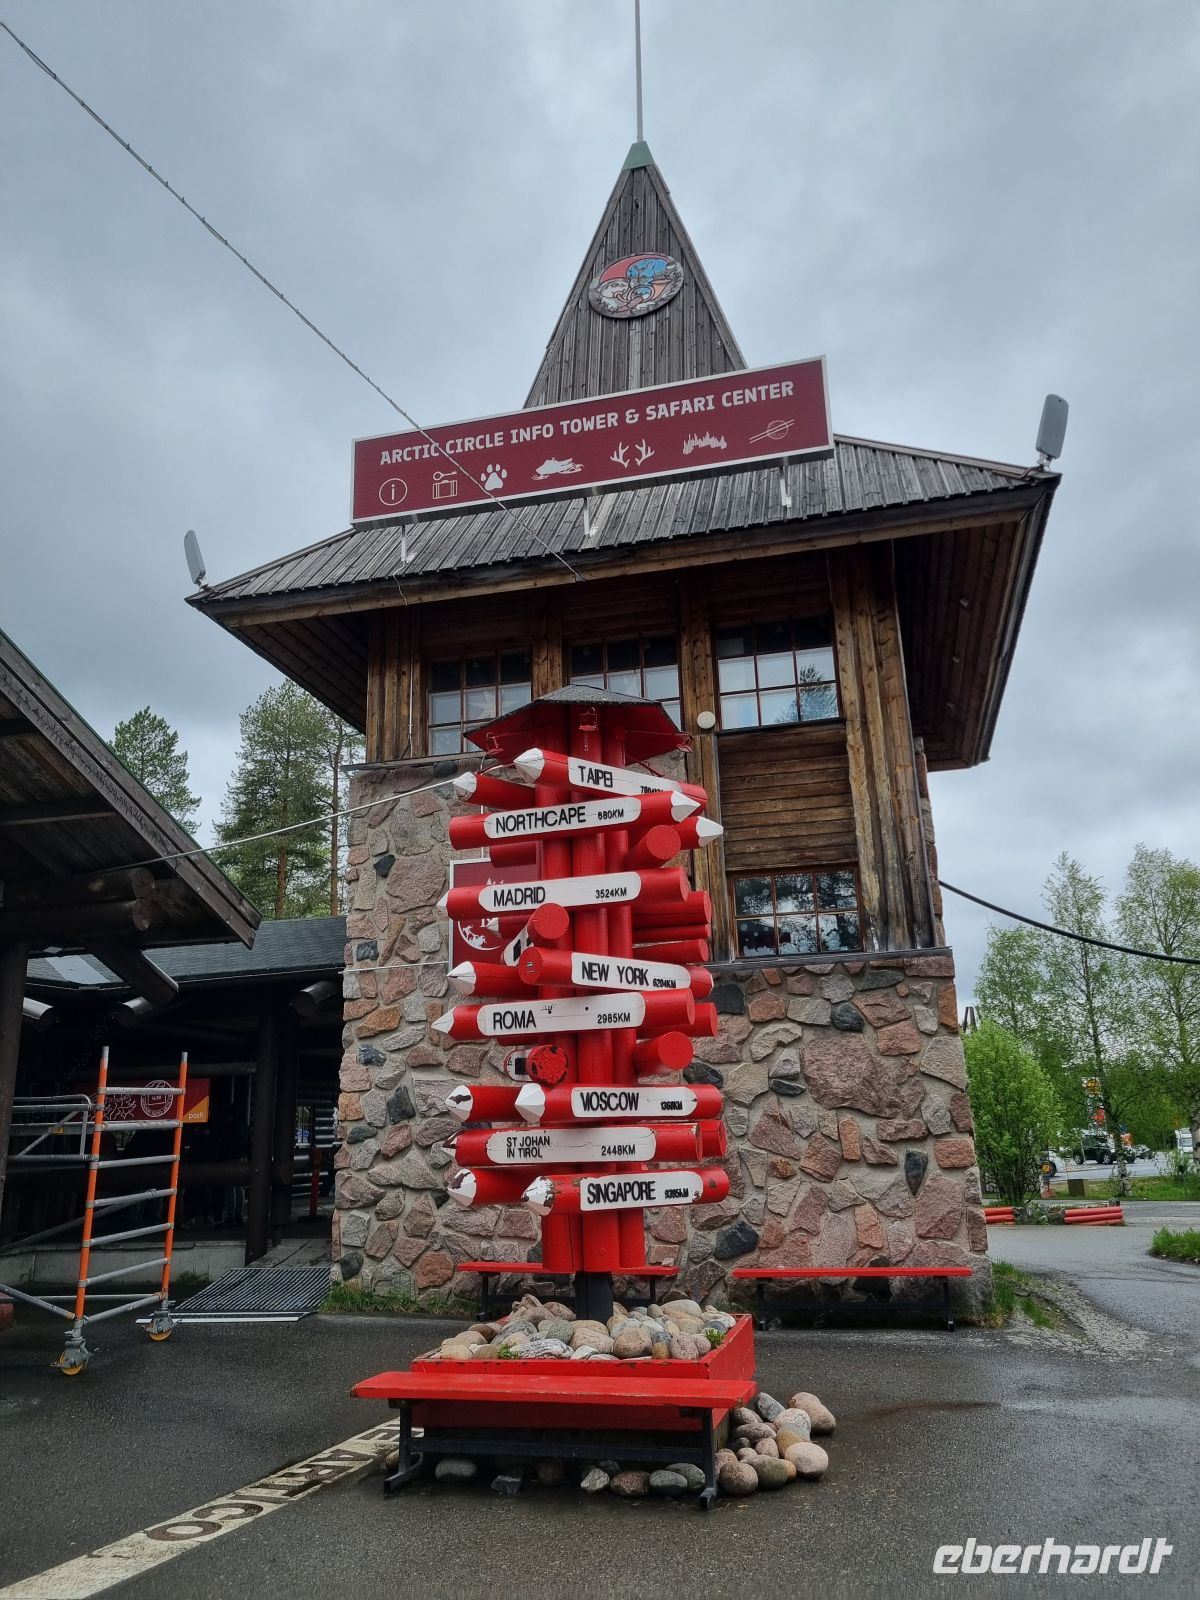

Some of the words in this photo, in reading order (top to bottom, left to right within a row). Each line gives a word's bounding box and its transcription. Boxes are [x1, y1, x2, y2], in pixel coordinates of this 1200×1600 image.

[379, 442, 440, 466] ARCTIC
[445, 431, 504, 454] CIRCLE
[510, 423, 554, 444] INFO
[560, 411, 619, 435] TOWER
[625, 408, 640, 424] &
[646, 394, 715, 421] SAFARI
[721, 380, 794, 407] CENTER
[578, 765, 613, 788] TAIPEI
[495, 806, 587, 834] NORTHCAPE
[493, 886, 546, 907] MADRID
[595, 887, 627, 899] 3524KM
[581, 961, 610, 982] NEW
[617, 965, 650, 986] YORK
[492, 1009, 537, 1030] ROMA
[597, 1012, 631, 1024] 2985KM
[580, 1091, 640, 1112] MOSCOW
[506, 1136, 518, 1147] ST
[519, 1135, 550, 1147] JOHAN
[601, 1144, 636, 1157] 2448KM
[506, 1148, 515, 1159] IN
[518, 1147, 543, 1159] TIROL
[587, 1180, 657, 1204] SINGAPORE
